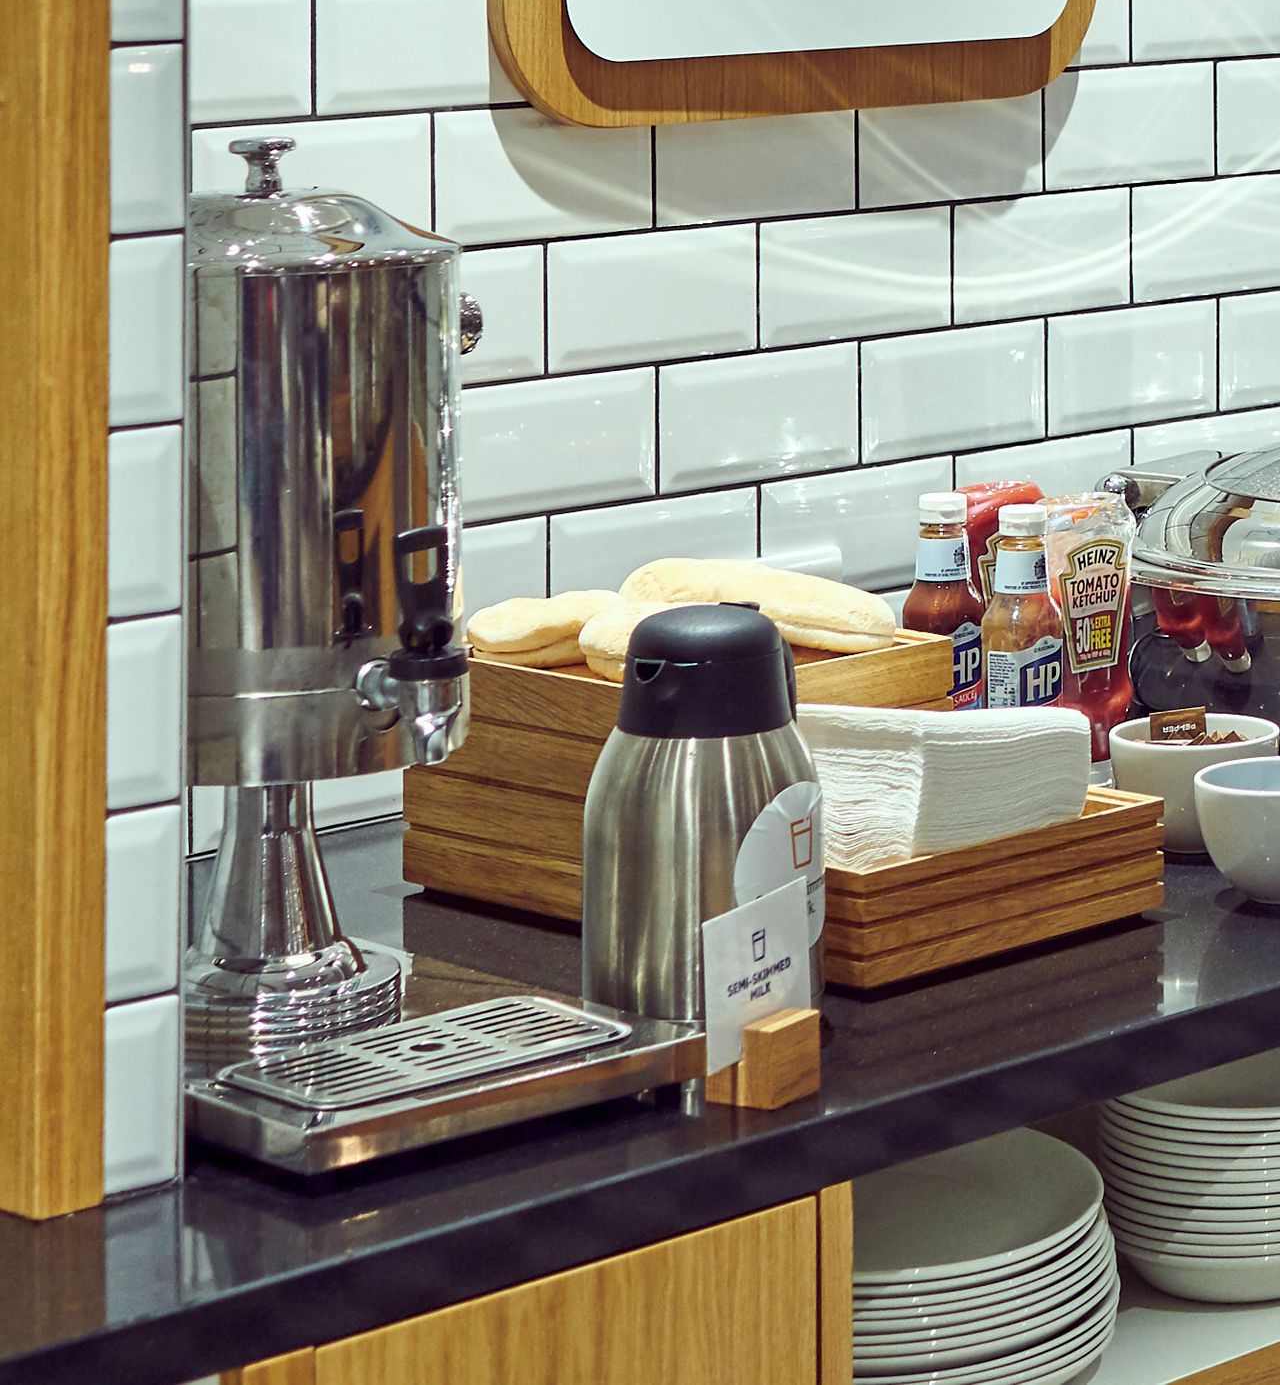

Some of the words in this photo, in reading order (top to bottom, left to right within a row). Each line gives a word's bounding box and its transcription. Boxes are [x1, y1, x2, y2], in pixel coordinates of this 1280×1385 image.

[1077, 549, 1116, 571] HEINZ
[1070, 572, 1120, 597] TOMATO
[1072, 589, 1117, 609] KETCHUP
[1095, 615, 1112, 628] EXTRA
[1090, 628, 1112, 650] FREE
[1026, 661, 1061, 702] HP
[727, 956, 792, 998] SEMI-SKIMMED
[749, 981, 772, 1002] MILK
